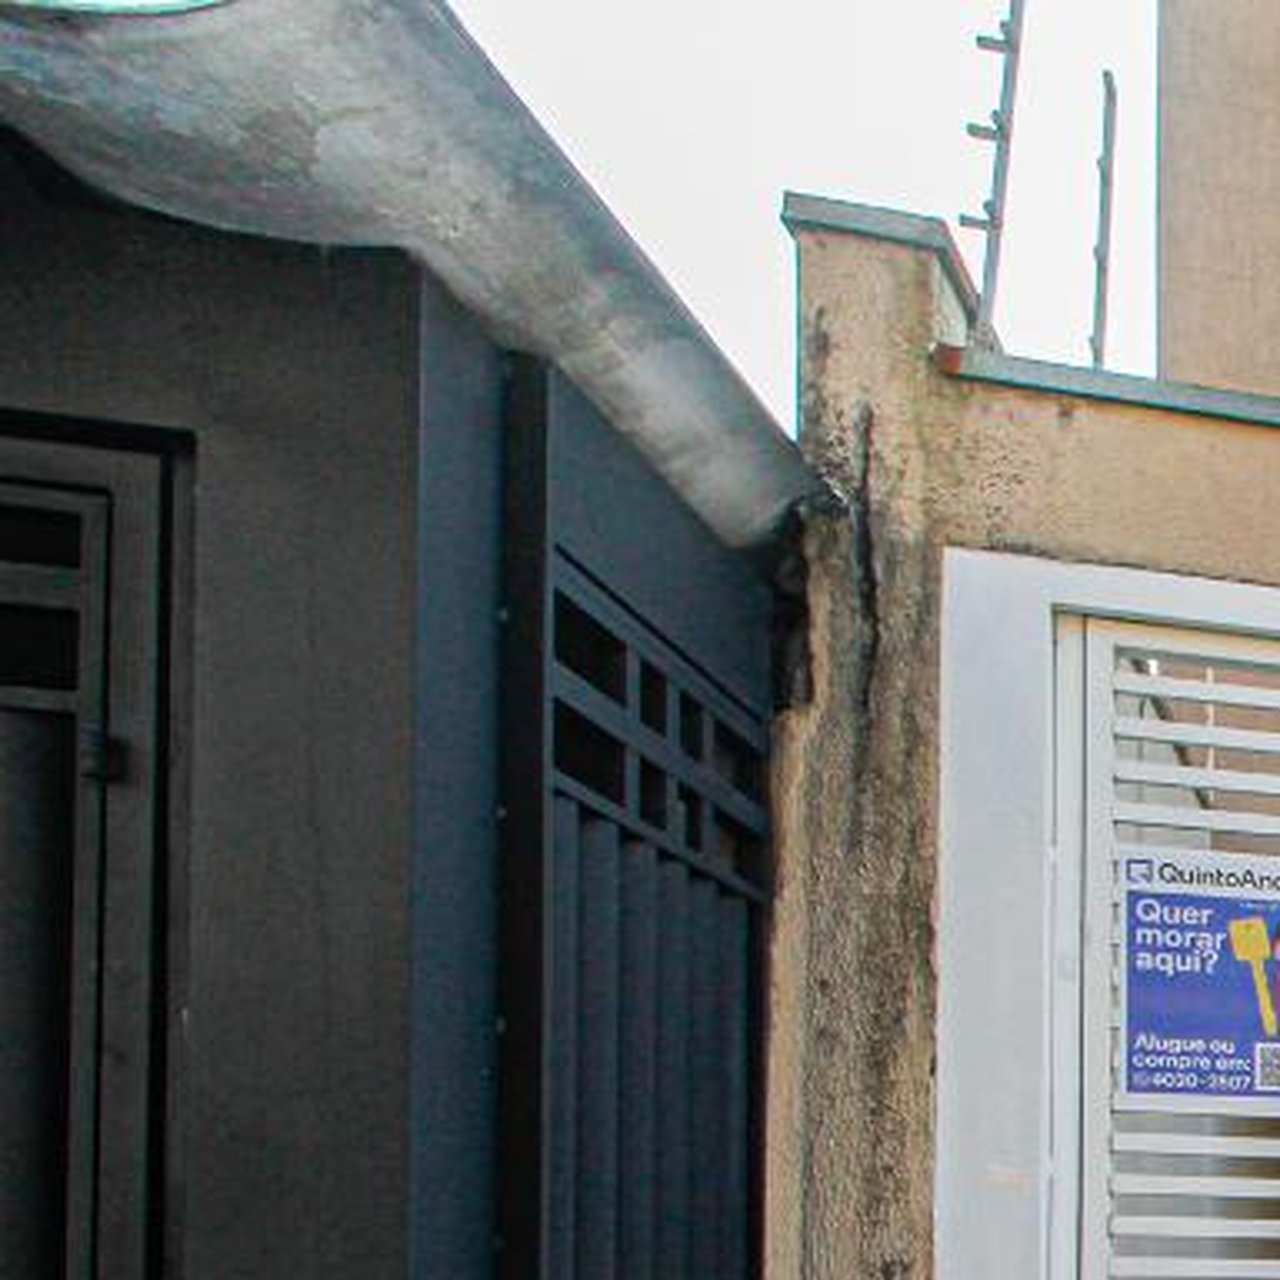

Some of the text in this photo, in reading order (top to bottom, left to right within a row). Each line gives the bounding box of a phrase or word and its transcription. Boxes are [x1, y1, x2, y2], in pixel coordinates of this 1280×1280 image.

[1135, 899, 1214, 925] Quer
[1135, 929, 1227, 950] morar
[1135, 951, 1219, 975] aqui?
[1133, 1034, 1236, 1054] Alugue ou
[1131, 1054, 1211, 1070] compre
